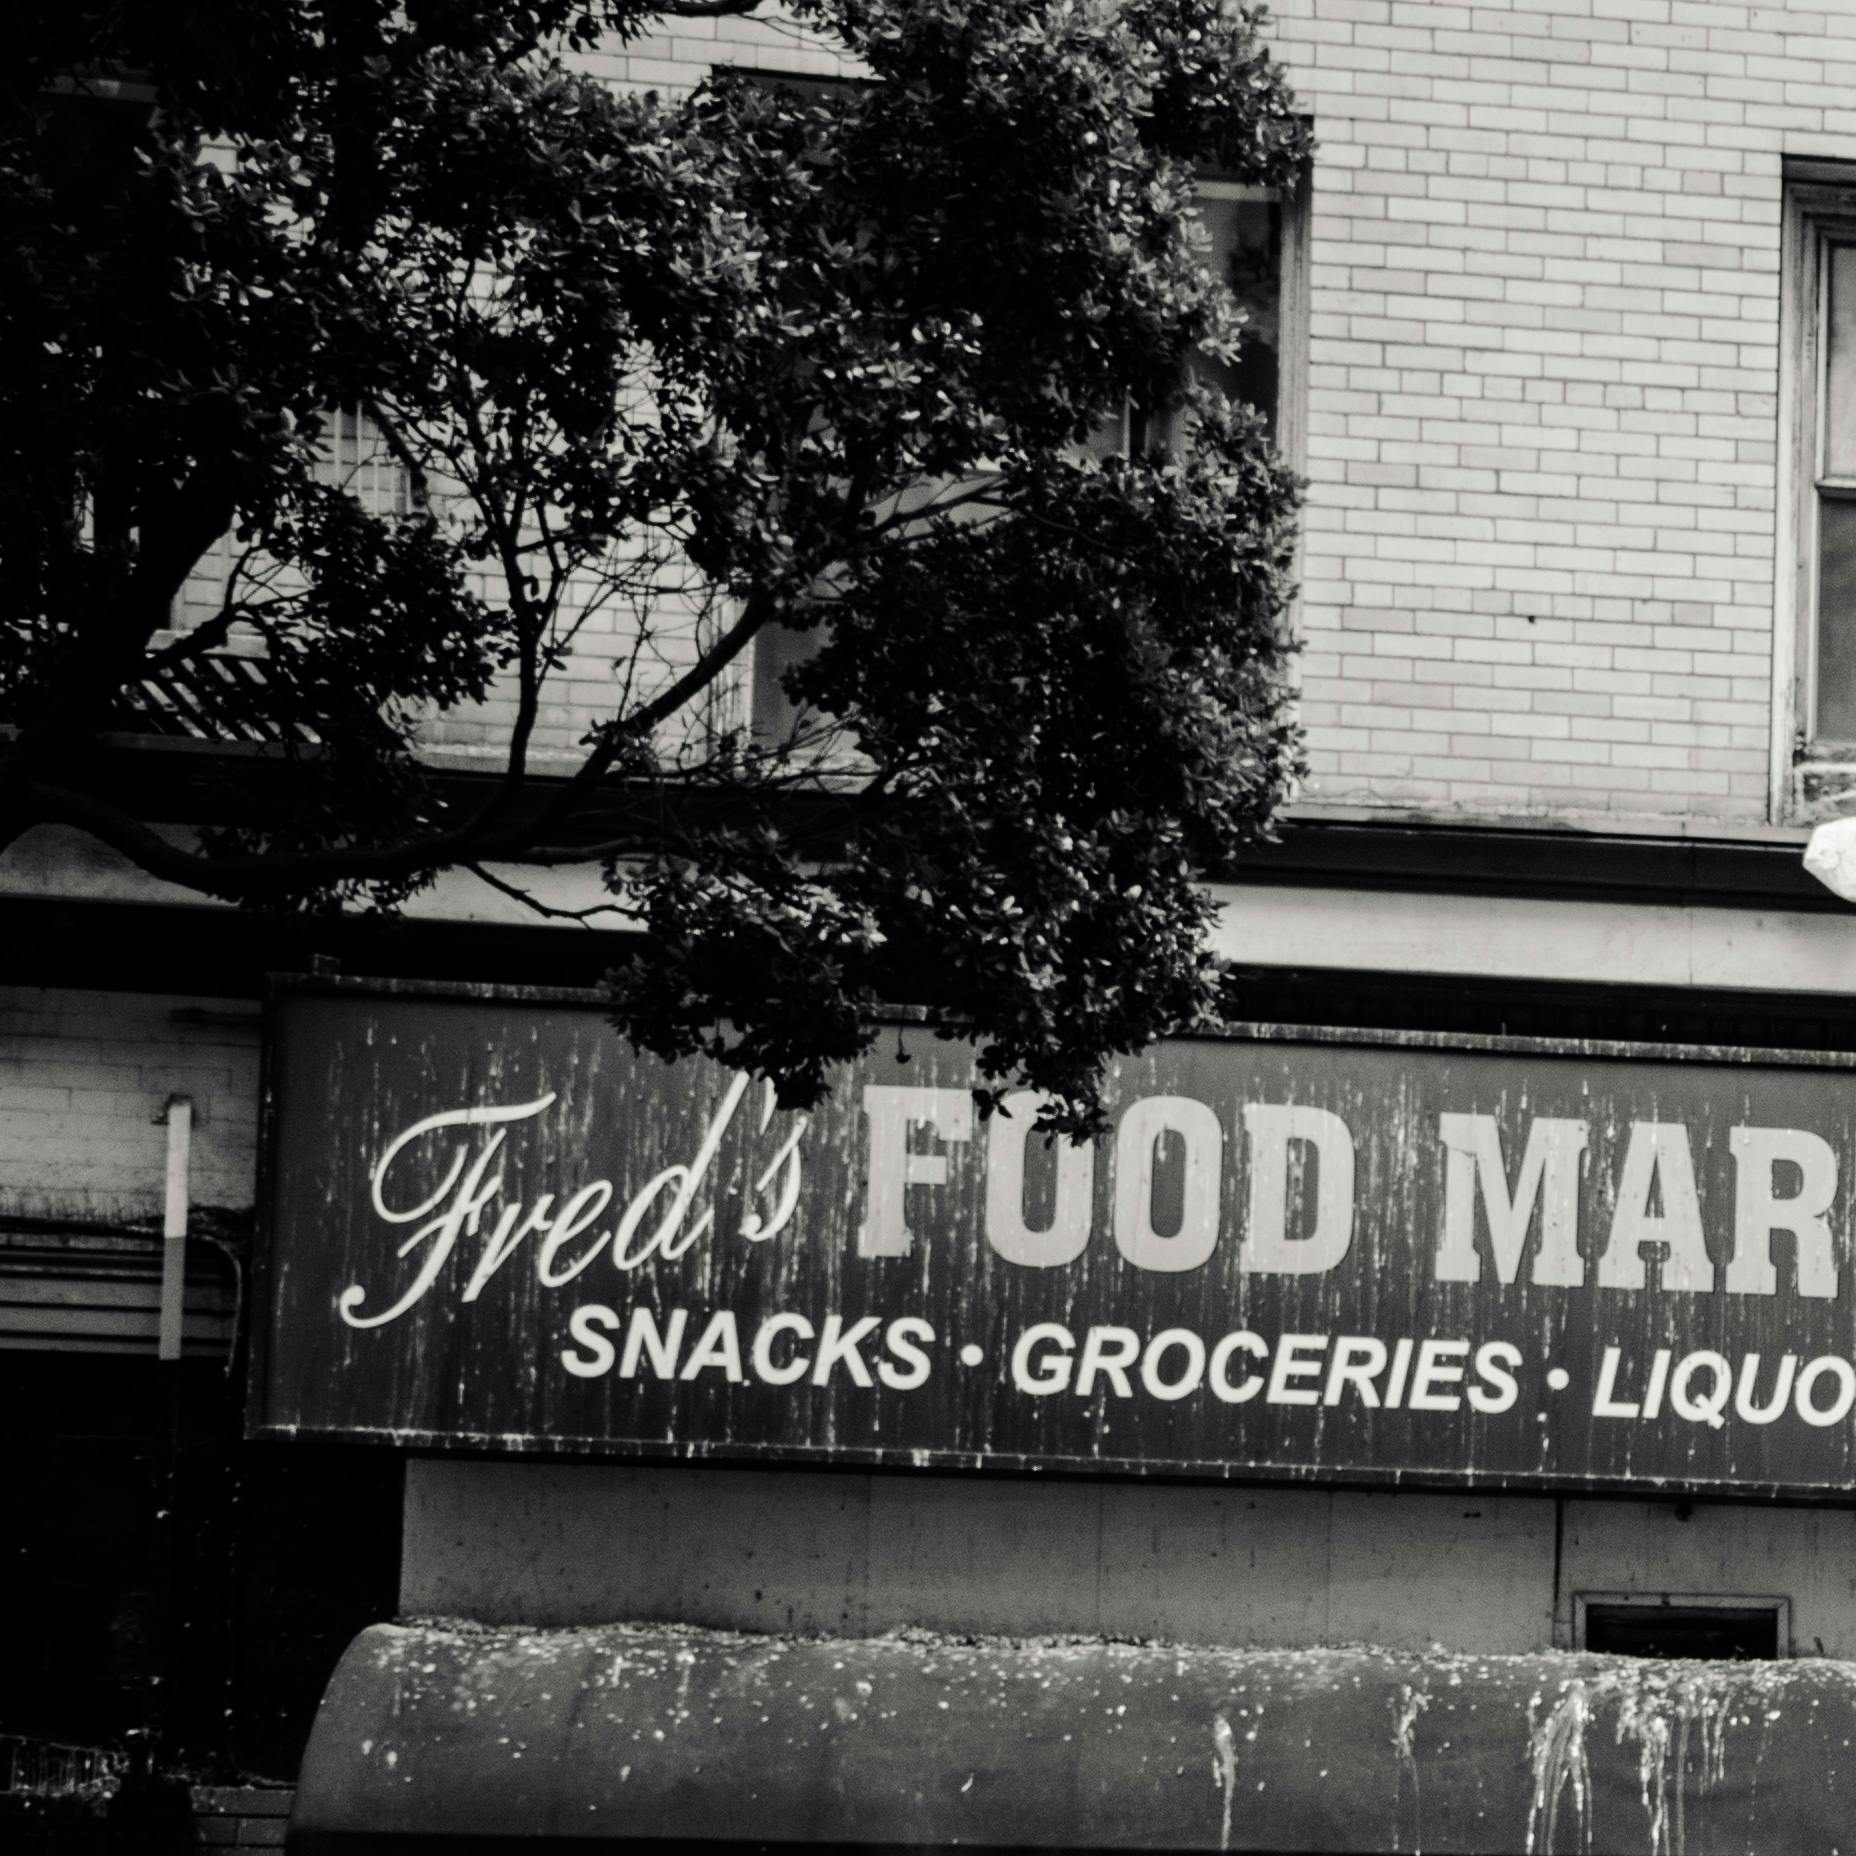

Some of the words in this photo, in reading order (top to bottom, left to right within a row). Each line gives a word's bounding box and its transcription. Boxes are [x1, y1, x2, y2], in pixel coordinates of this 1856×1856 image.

[339, 1071, 810, 1330] Fred's
[858, 1084, 1357, 1276] FOOD
[561, 1303, 936, 1390] SNACKS
[1011, 1321, 1523, 1415] GROCERIES
